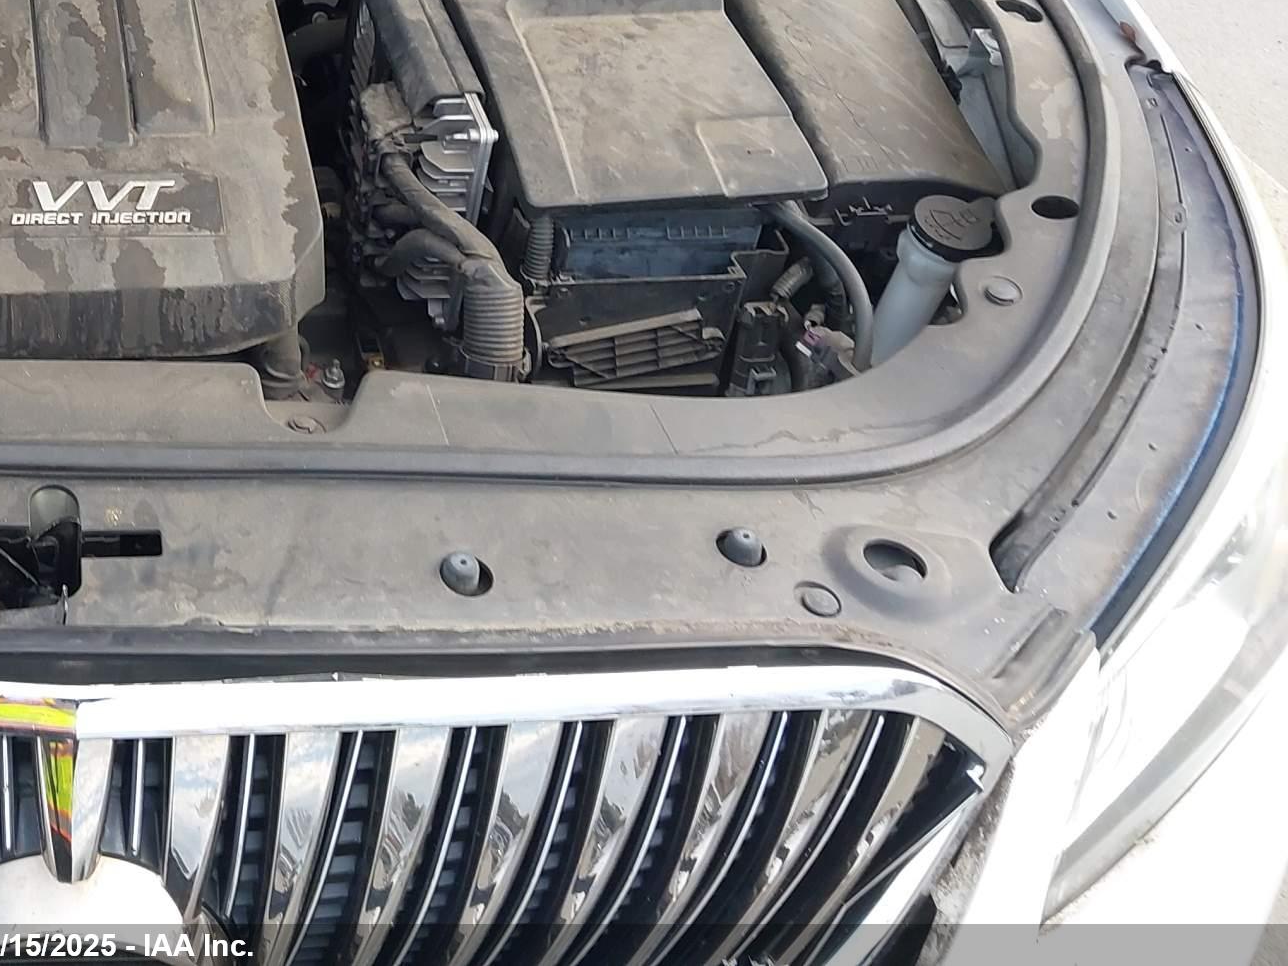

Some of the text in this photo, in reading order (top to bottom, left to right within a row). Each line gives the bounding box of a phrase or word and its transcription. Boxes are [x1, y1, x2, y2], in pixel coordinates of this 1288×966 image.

[32, 180, 176, 212] VVT
[11, 210, 191, 226] DIRECT INJECTION
